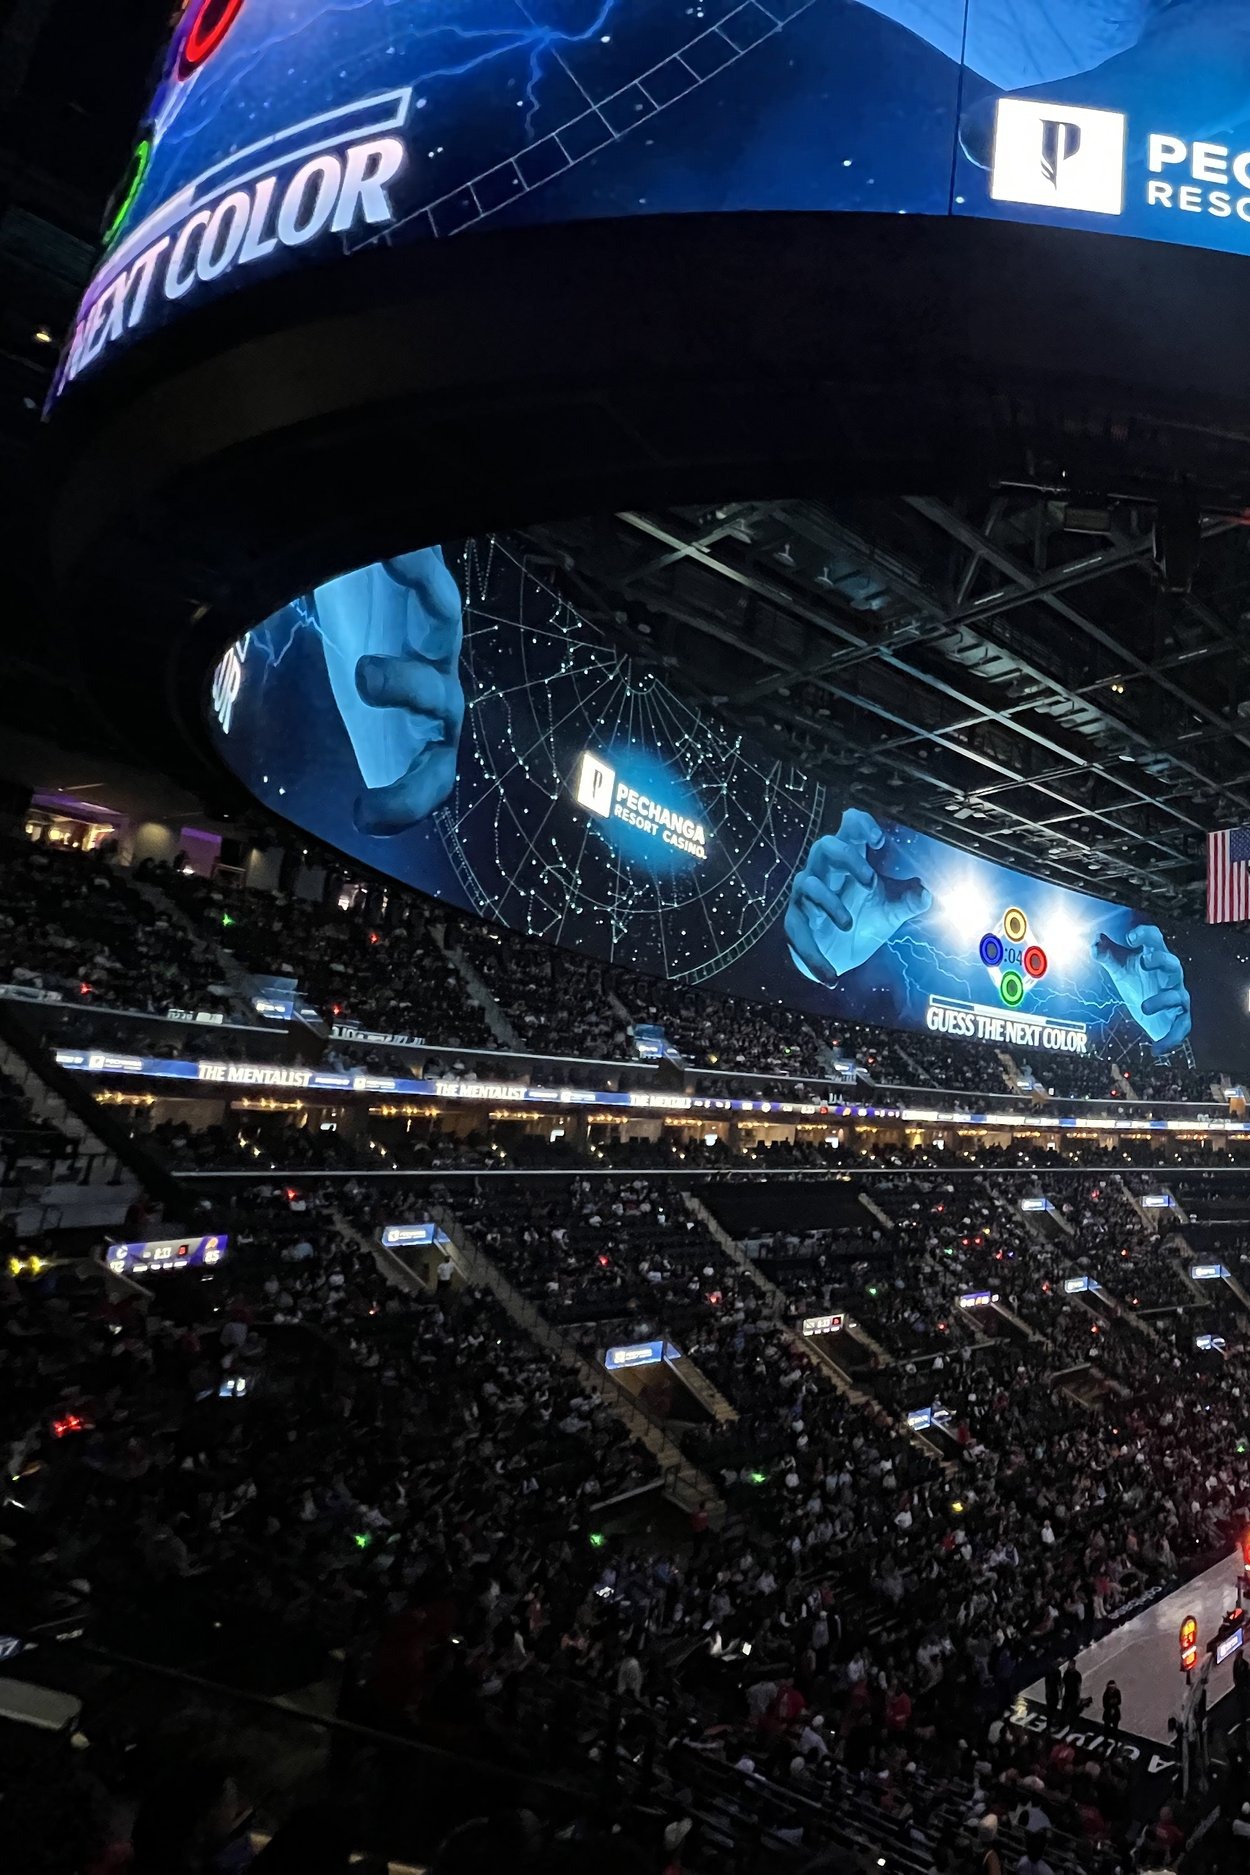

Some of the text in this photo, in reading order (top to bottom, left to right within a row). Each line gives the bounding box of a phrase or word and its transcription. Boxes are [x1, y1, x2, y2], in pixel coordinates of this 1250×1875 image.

[164, 137, 405, 300] COLOR
[614, 803, 659, 836] RESORT
[615, 782, 706, 845] PECHANGA
[926, 1006, 1088, 1053] GUESS THE NEXT COLOR
[198, 1064, 225, 1080] THE
[227, 1067, 313, 1087] MENTALIST
[435, 1082, 459, 1097] THE
[459, 1084, 528, 1100] MENTALIST
